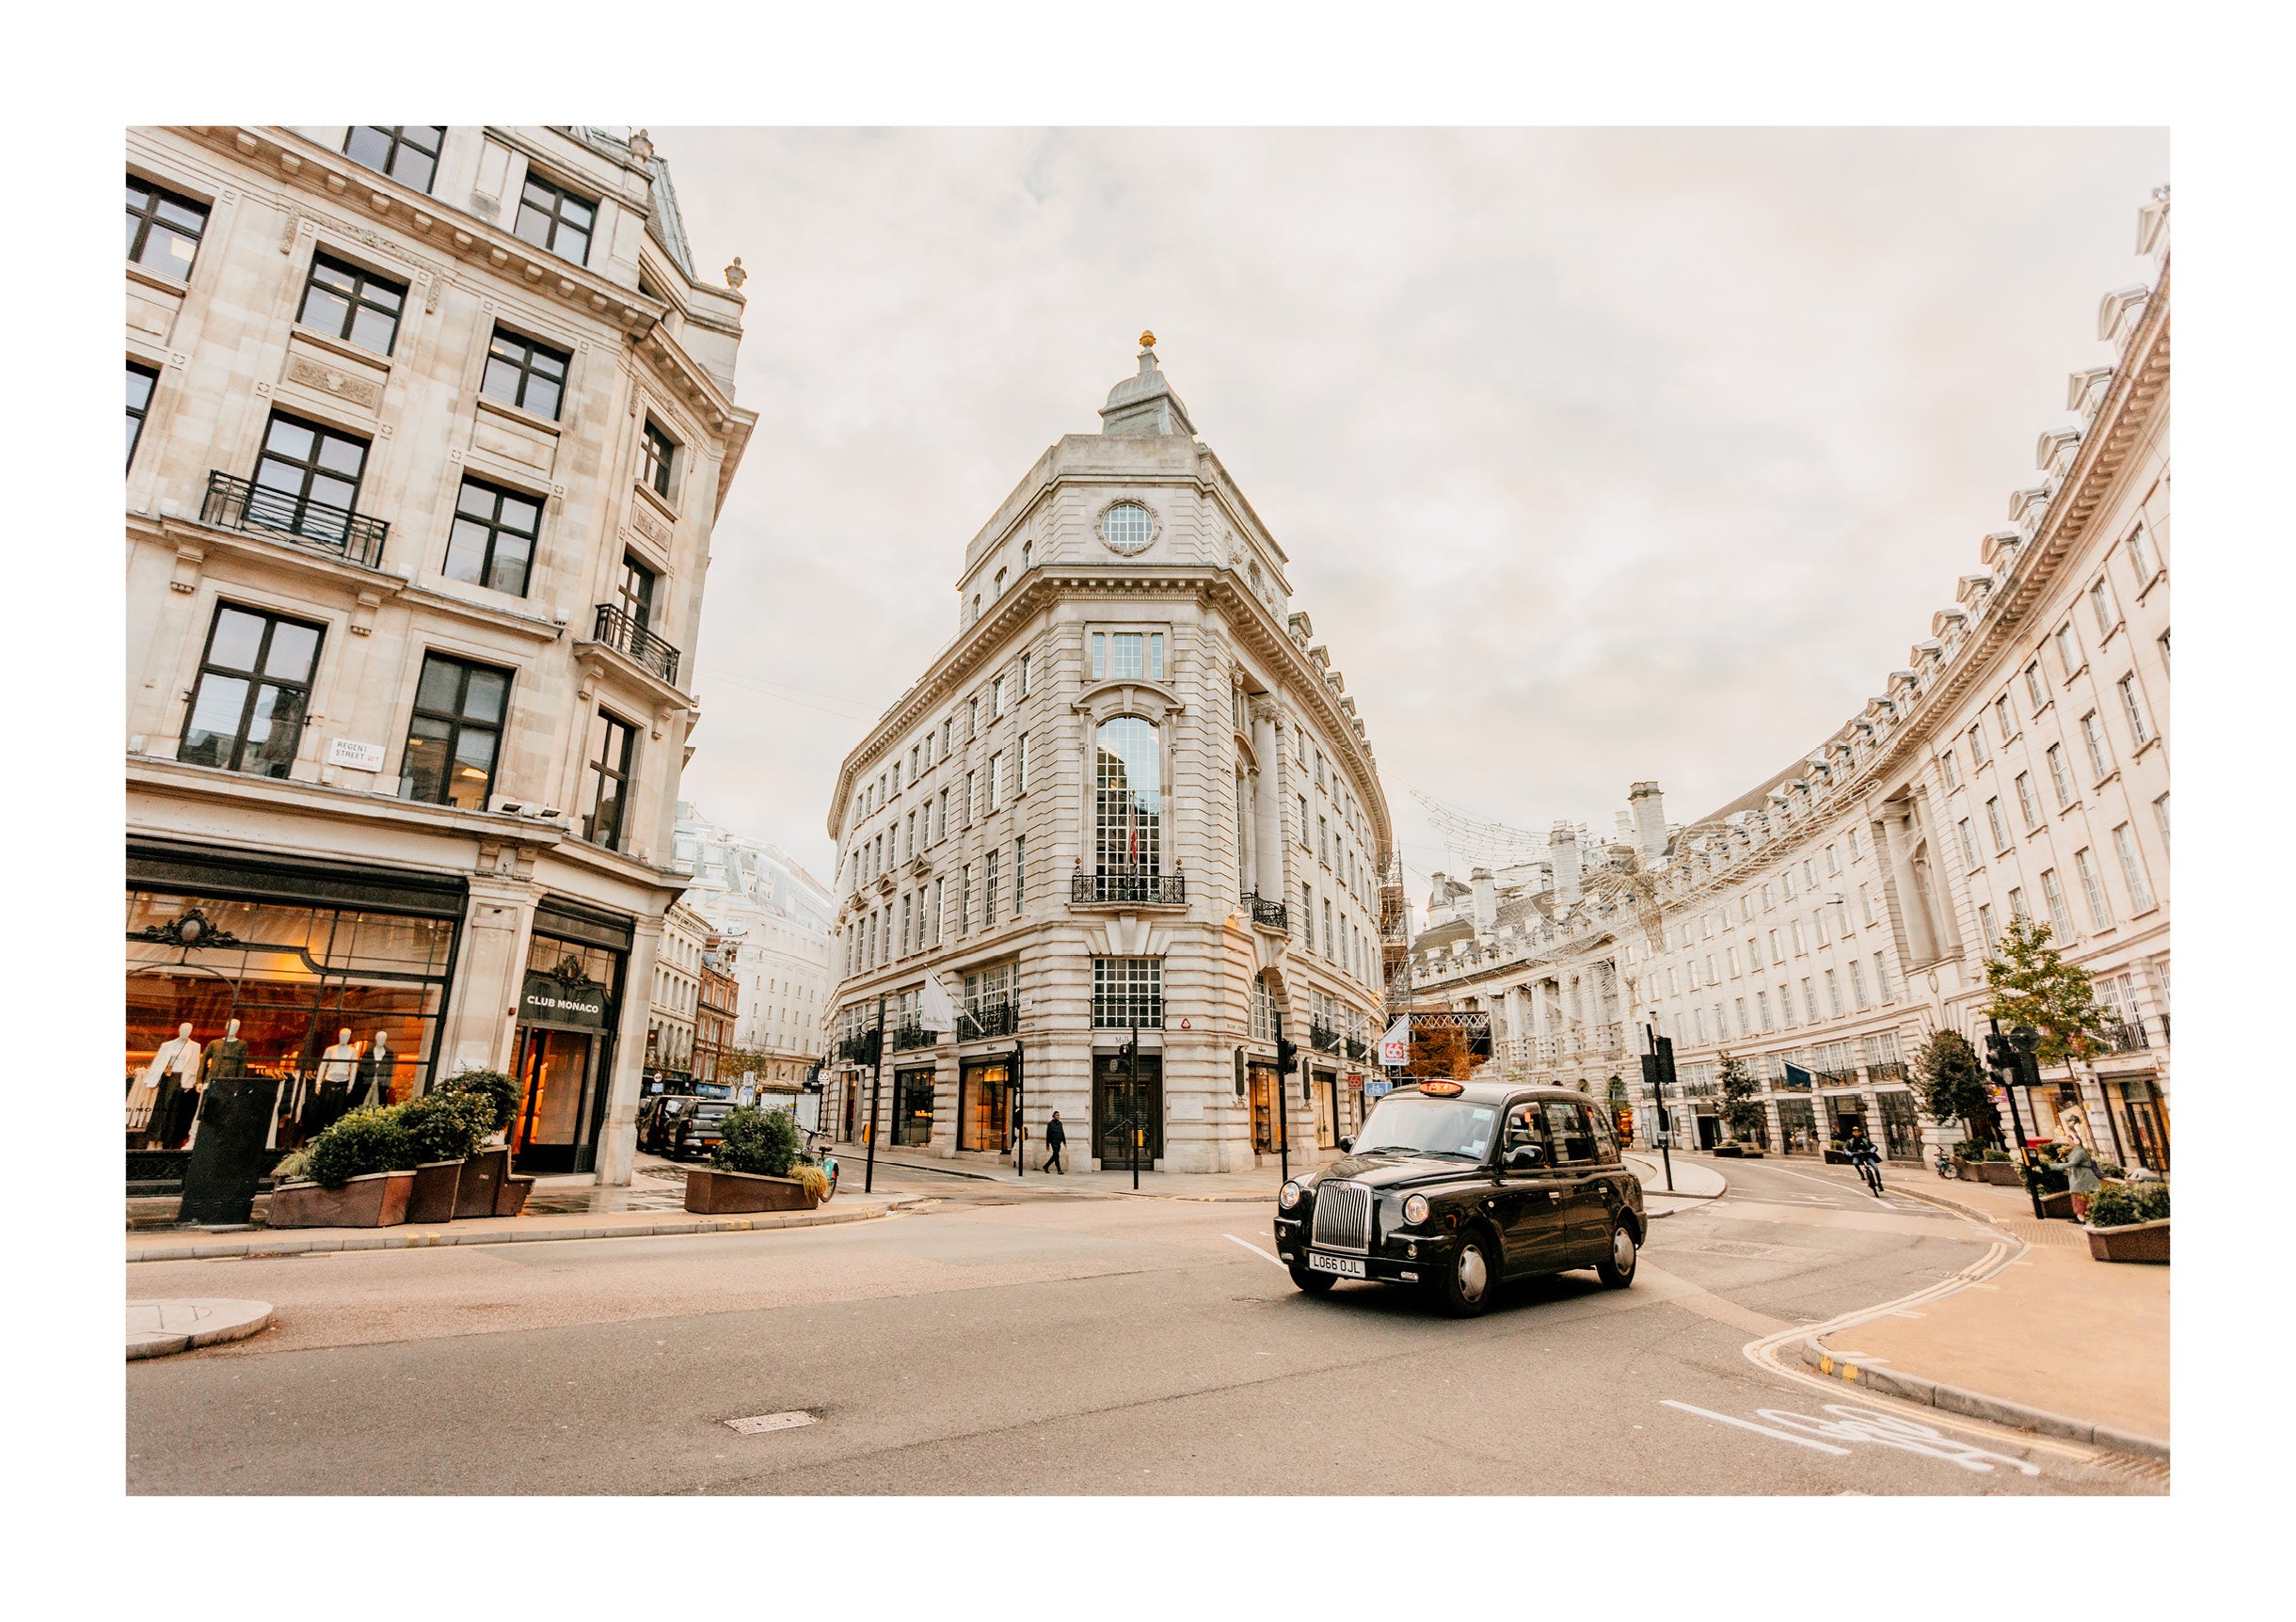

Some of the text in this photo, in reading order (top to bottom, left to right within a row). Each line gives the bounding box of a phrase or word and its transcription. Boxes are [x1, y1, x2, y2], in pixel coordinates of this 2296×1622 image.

[335, 749, 364, 759] STREET
[337, 741, 367, 753] REGENT
[527, 995, 599, 1013] CLUB MONACO
[1386, 1042, 1403, 1058] 66
[1348, 1077, 1360, 1086] 66
[1313, 1255, 1361, 1274] LO66 OJL
